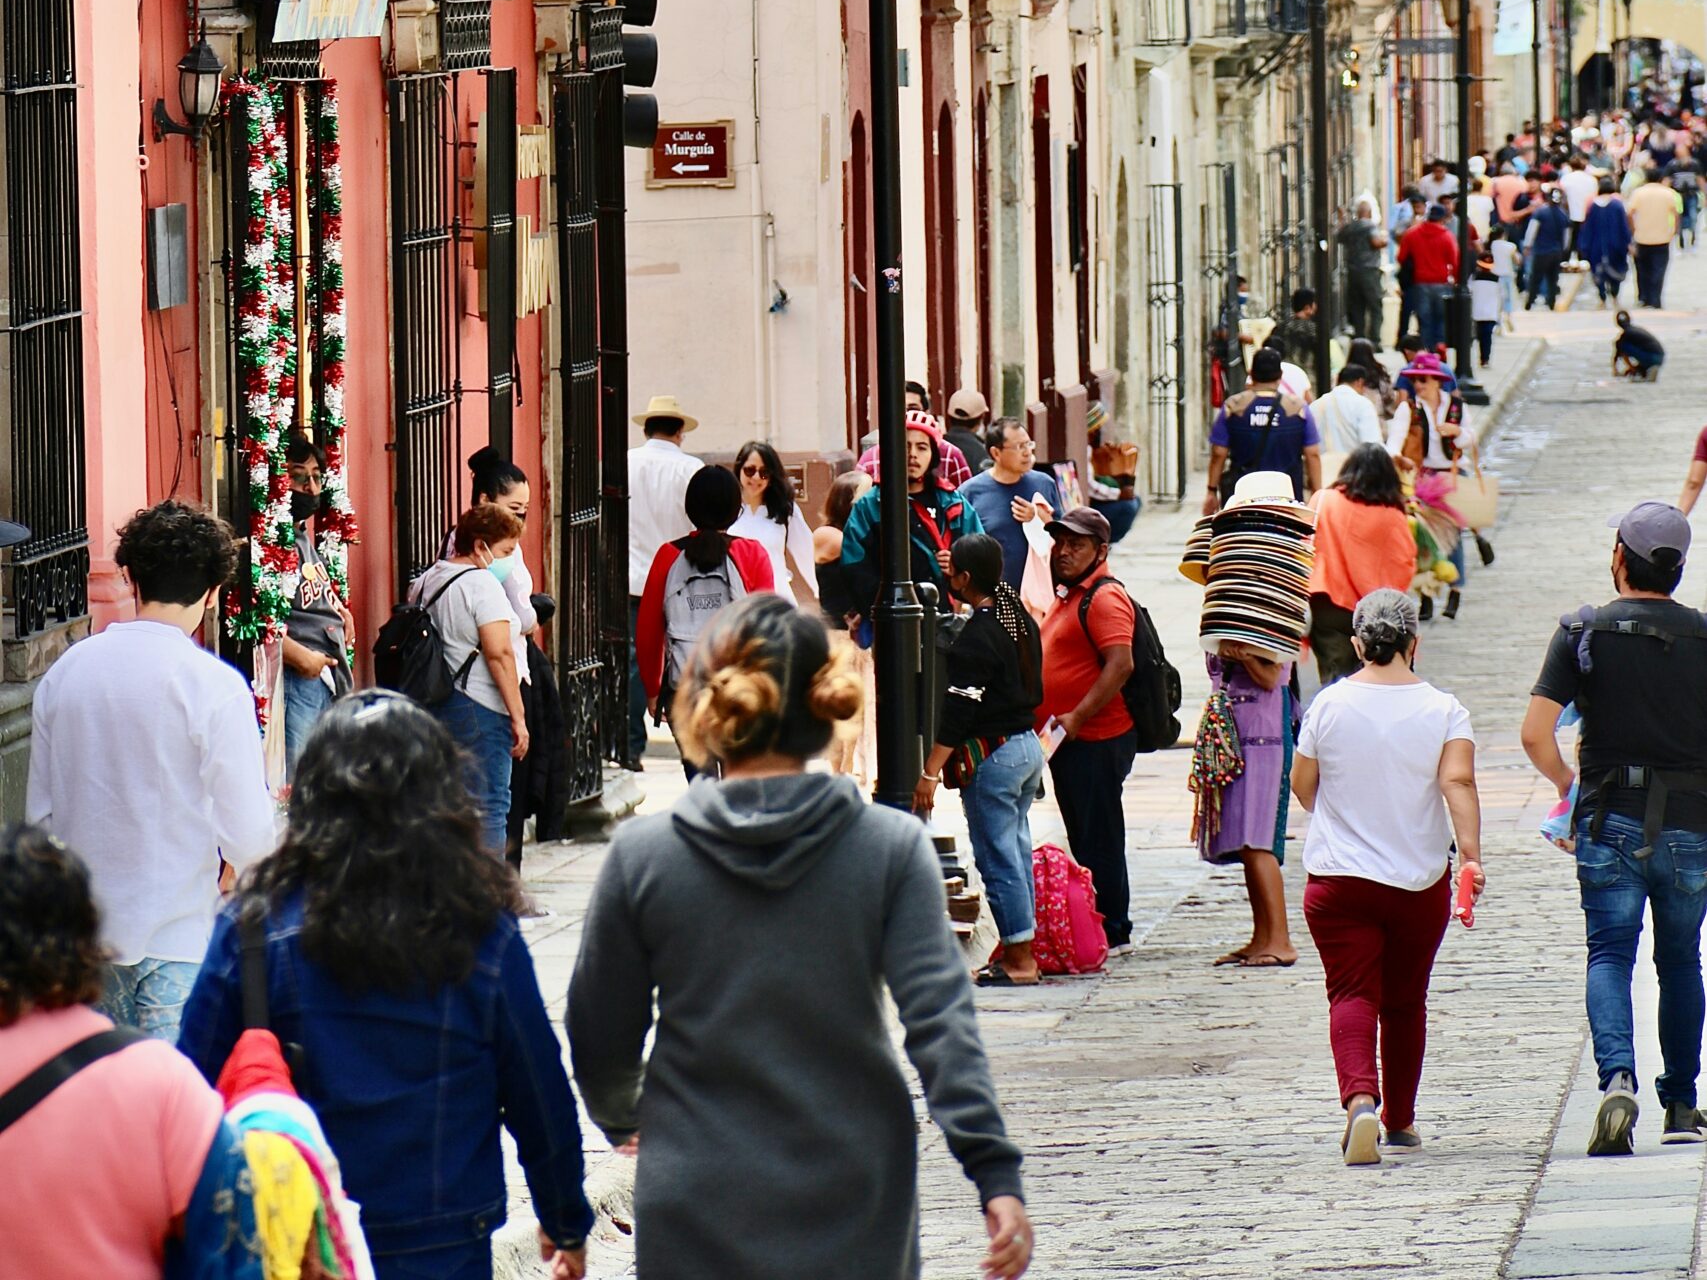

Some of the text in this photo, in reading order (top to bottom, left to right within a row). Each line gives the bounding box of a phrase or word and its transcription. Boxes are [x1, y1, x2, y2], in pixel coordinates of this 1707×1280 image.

[672, 131, 706, 140] Calle de
[664, 142, 714, 158] Murguía
[686, 593, 722, 611] VANS
